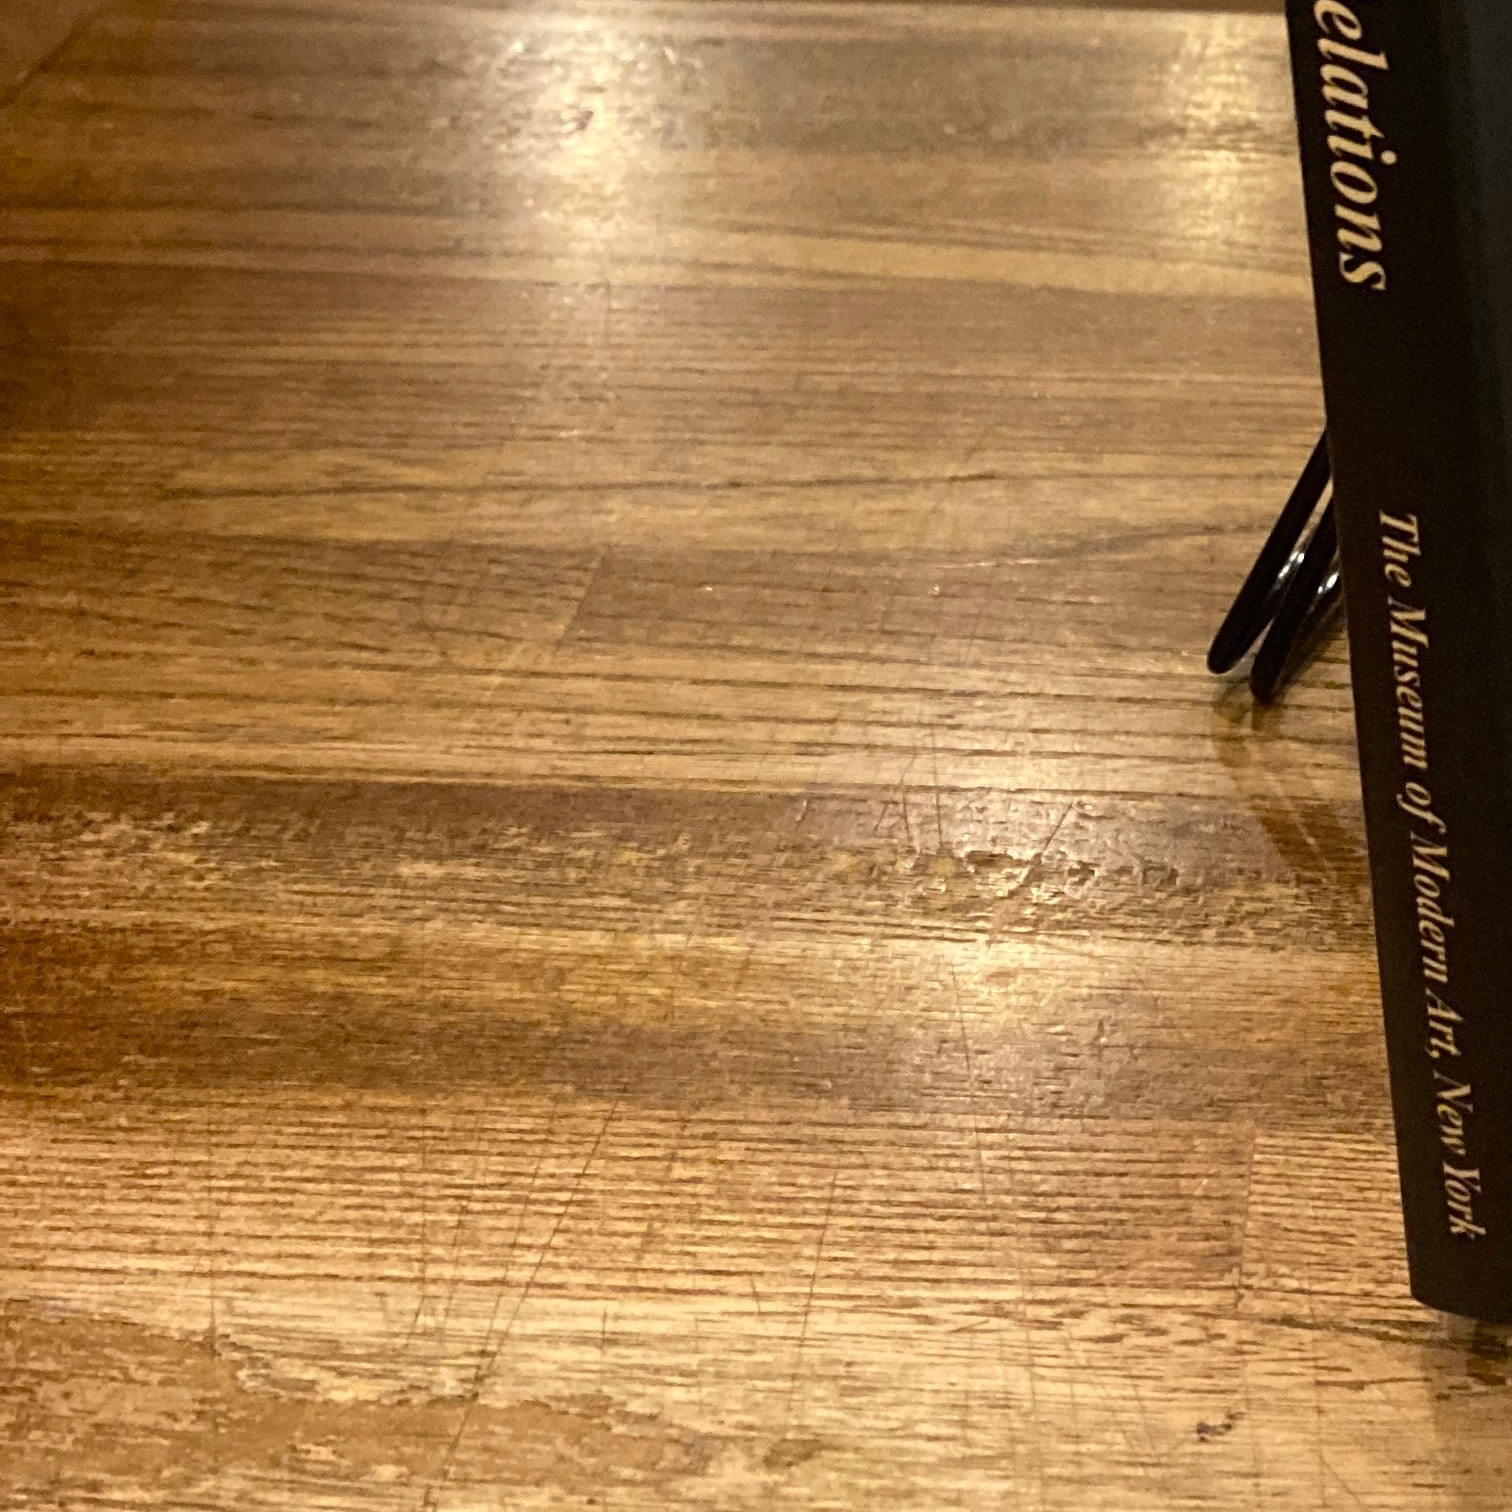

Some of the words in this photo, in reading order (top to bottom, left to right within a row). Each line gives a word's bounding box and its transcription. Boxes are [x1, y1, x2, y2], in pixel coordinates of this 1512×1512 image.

[1379, 508, 1422, 587] The
[1387, 595, 1430, 771] Museum
[1396, 782, 1447, 835] of
[1410, 828, 1456, 984] Modern
[1425, 987, 1465, 1060] Art,
[1433, 1067, 1474, 1157] New
[1441, 1158, 1487, 1240] York
